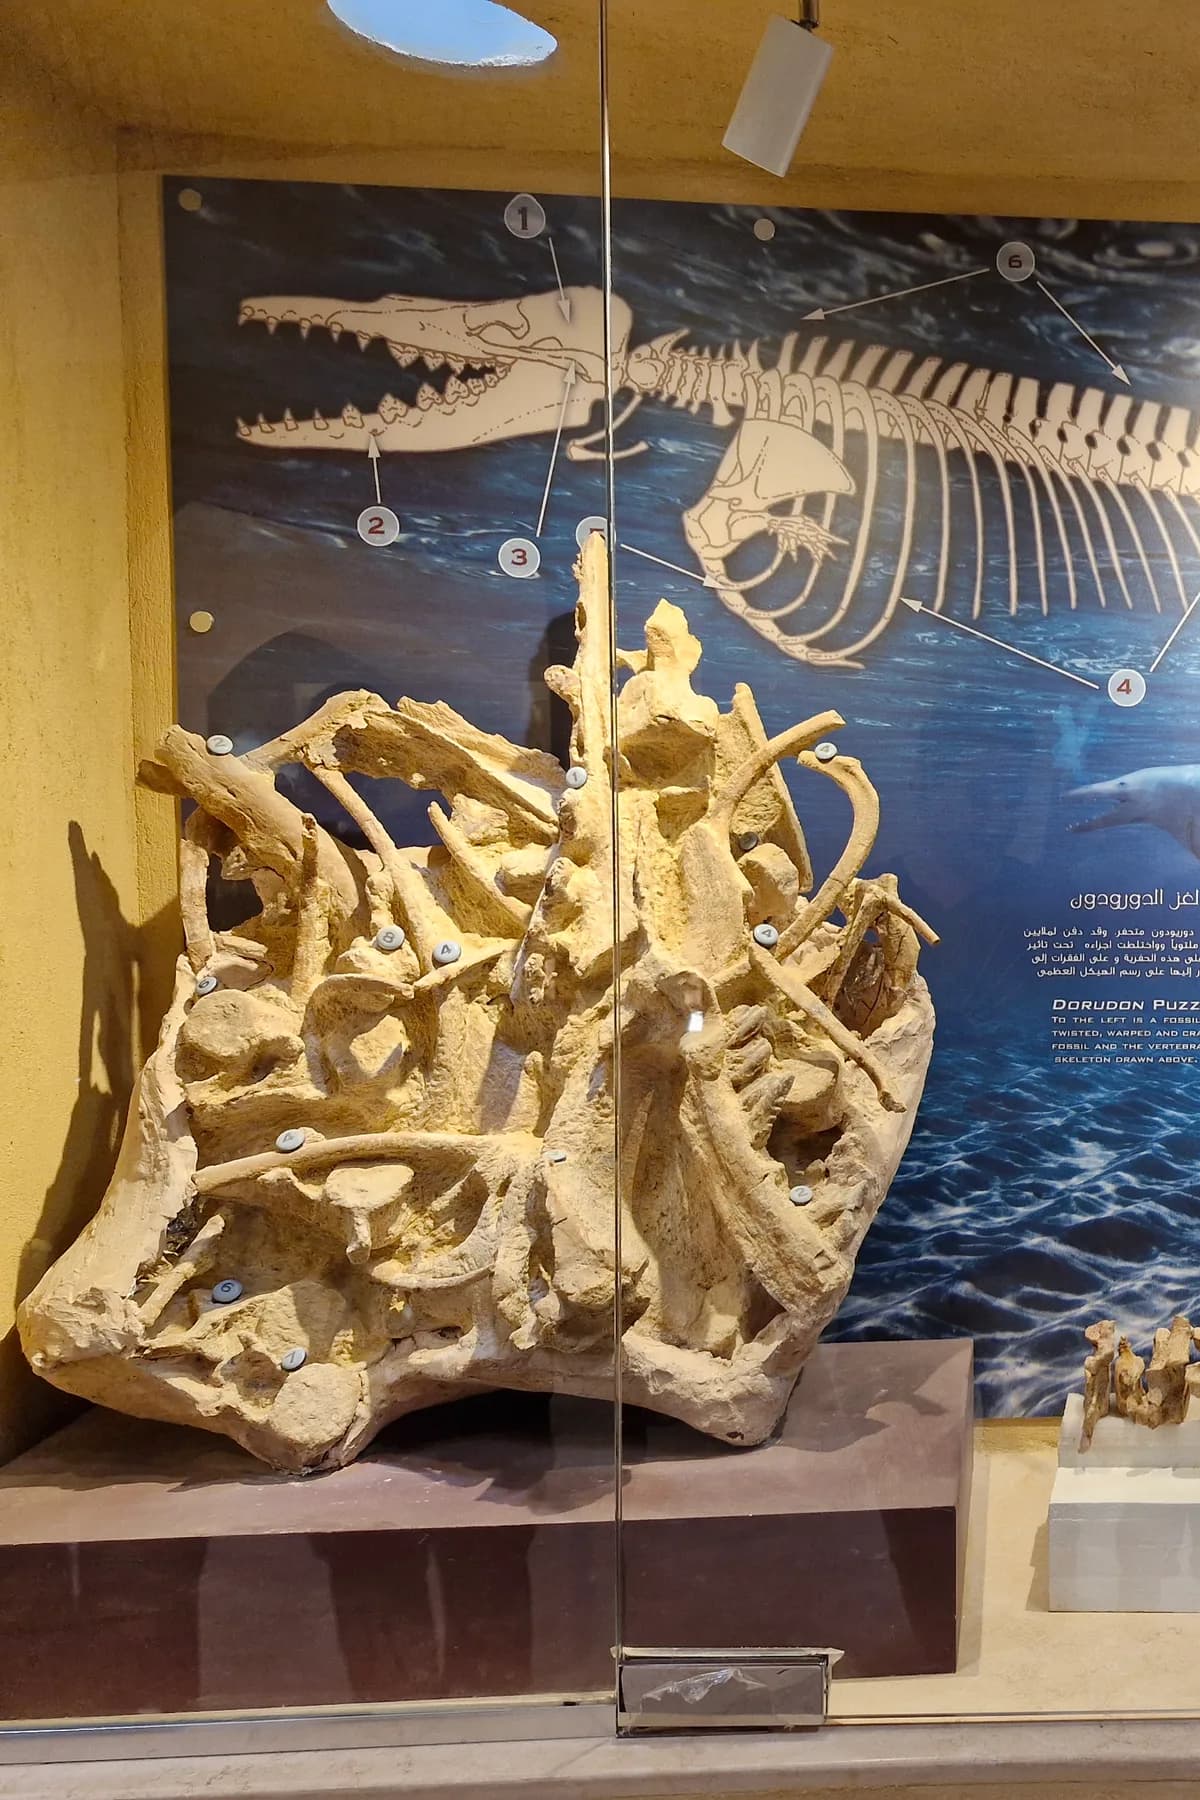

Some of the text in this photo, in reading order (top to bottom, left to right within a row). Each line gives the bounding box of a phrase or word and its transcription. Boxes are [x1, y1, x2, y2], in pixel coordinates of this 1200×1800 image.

[518, 207, 527, 230] 1
[1008, 255, 1022, 268] 6
[368, 517, 384, 535] 2
[512, 549, 526, 565] 3
[1117, 679, 1131, 694] 4
[383, 932, 392, 942] 8
[441, 945, 451, 955] 4
[221, 1282, 231, 1292] 6
